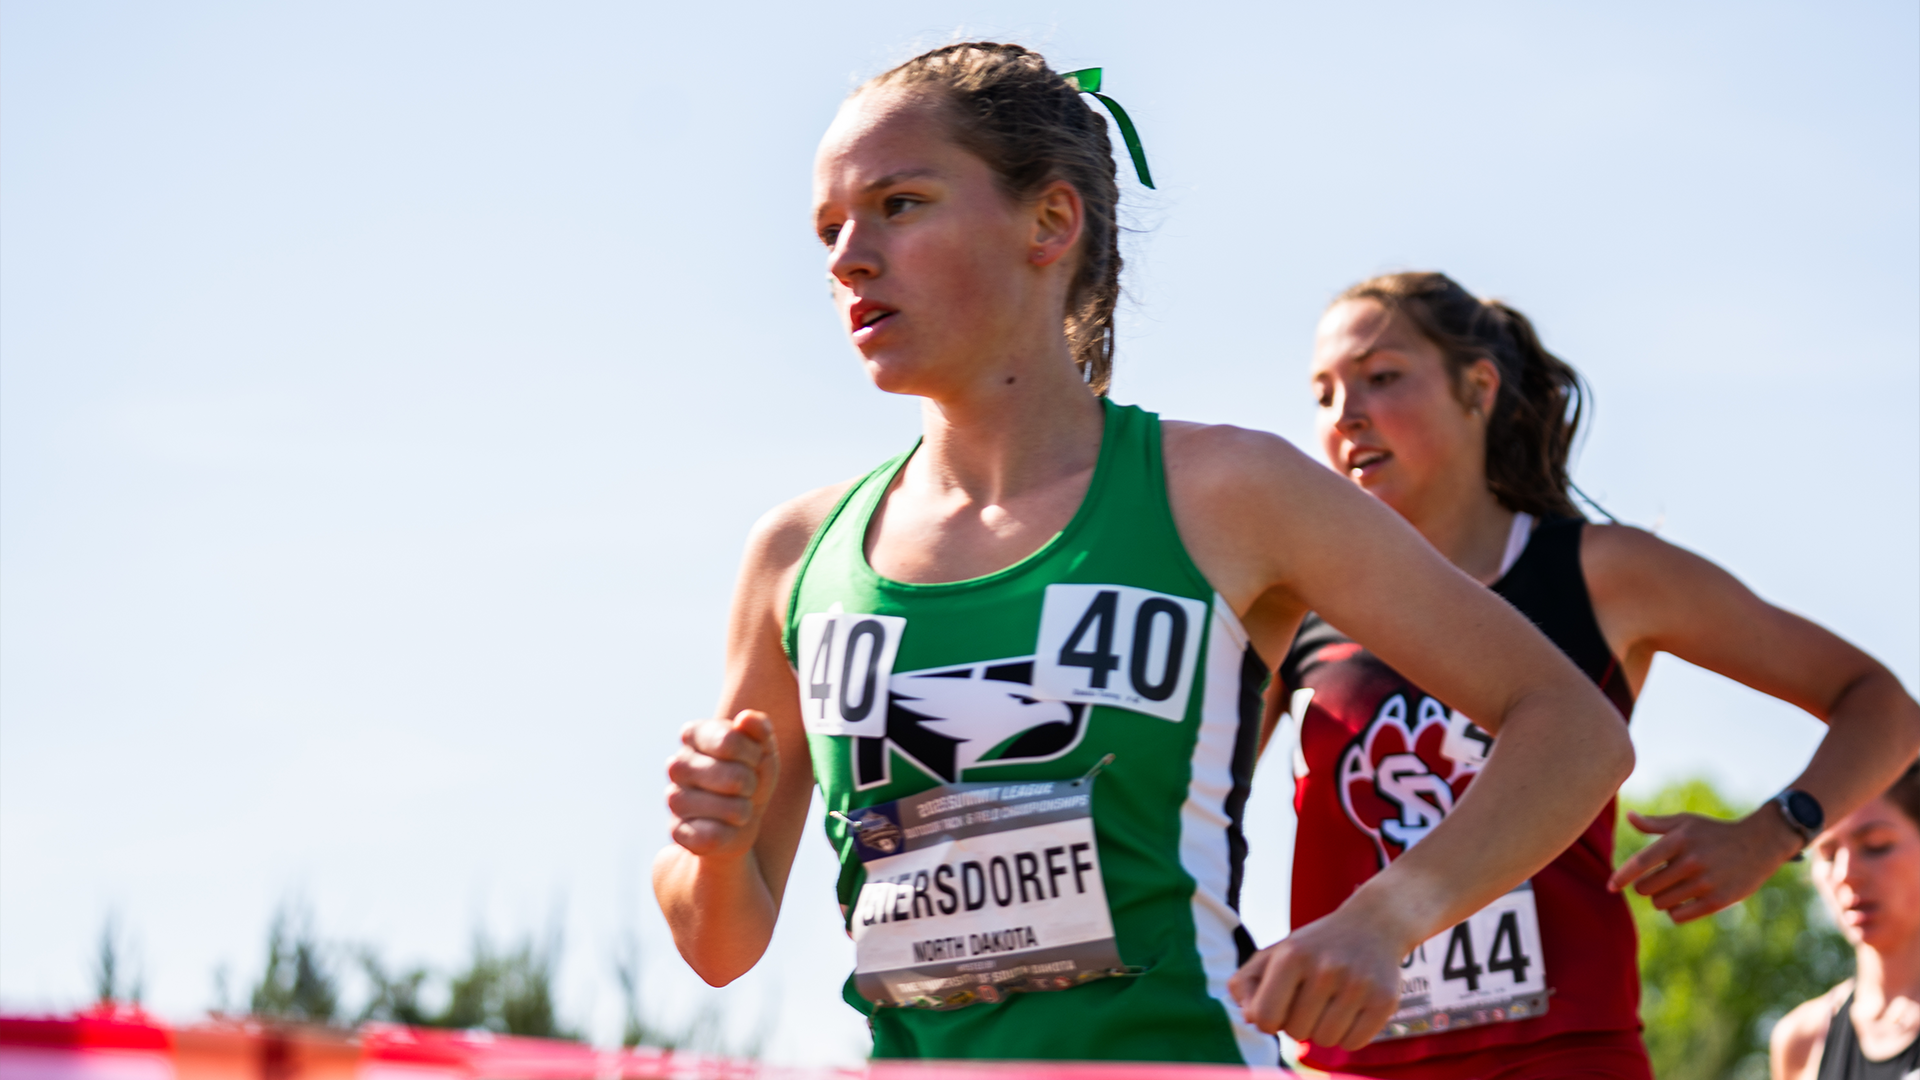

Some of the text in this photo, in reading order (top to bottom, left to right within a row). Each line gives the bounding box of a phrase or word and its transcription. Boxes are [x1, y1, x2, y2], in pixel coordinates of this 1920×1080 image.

[809, 618, 886, 723] 40
[1058, 591, 1189, 702] 40
[1000, 782, 1055, 801] LEAGUE
[912, 925, 1040, 963] NORTH DAKOTA
[1442, 910, 1531, 992] 44
